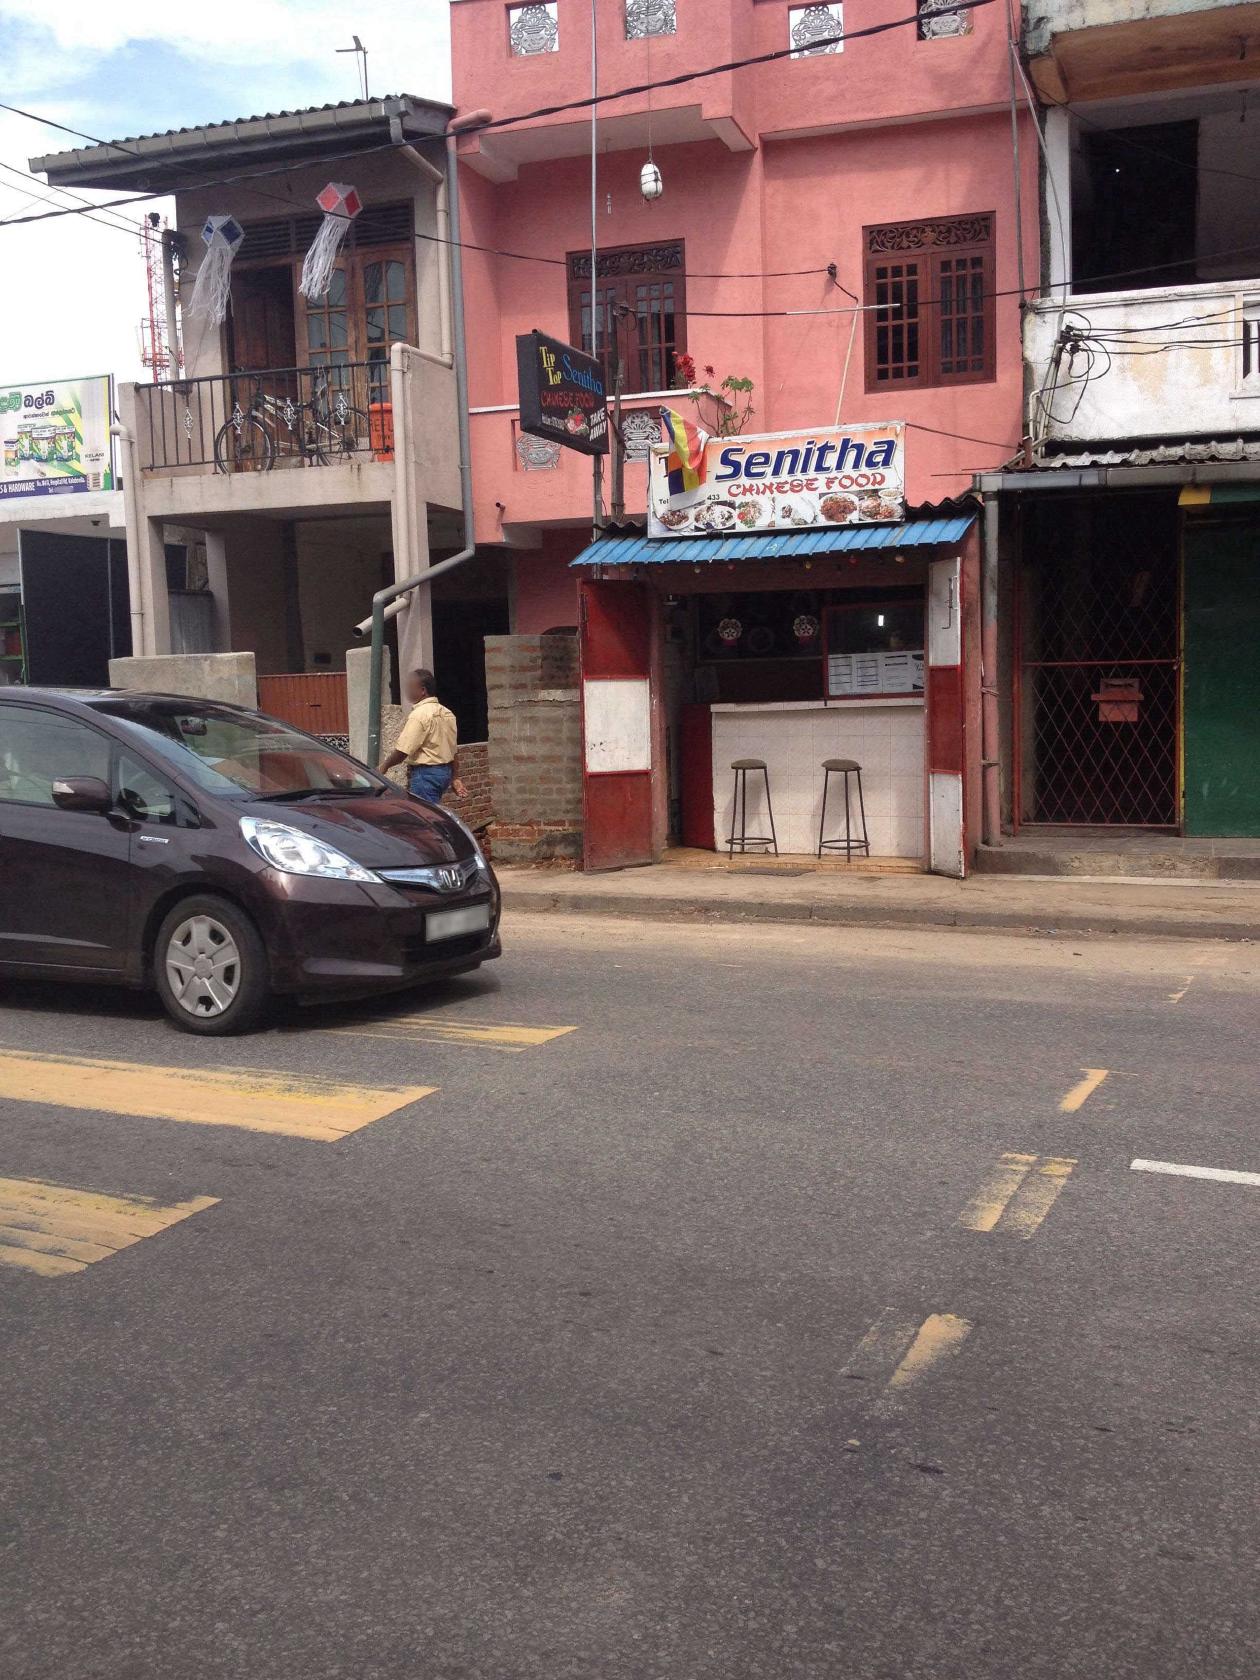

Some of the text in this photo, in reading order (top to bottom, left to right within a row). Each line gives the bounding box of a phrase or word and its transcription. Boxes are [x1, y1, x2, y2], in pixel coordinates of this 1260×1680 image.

[562, 353, 603, 395] Senitha
[590, 407, 606, 426] TAKE
[589, 420, 608, 442] AWAY
[715, 437, 897, 482] Senitha
[8, 482, 35, 493] HARDWARE
[727, 472, 887, 498] CHINESE FOOD
